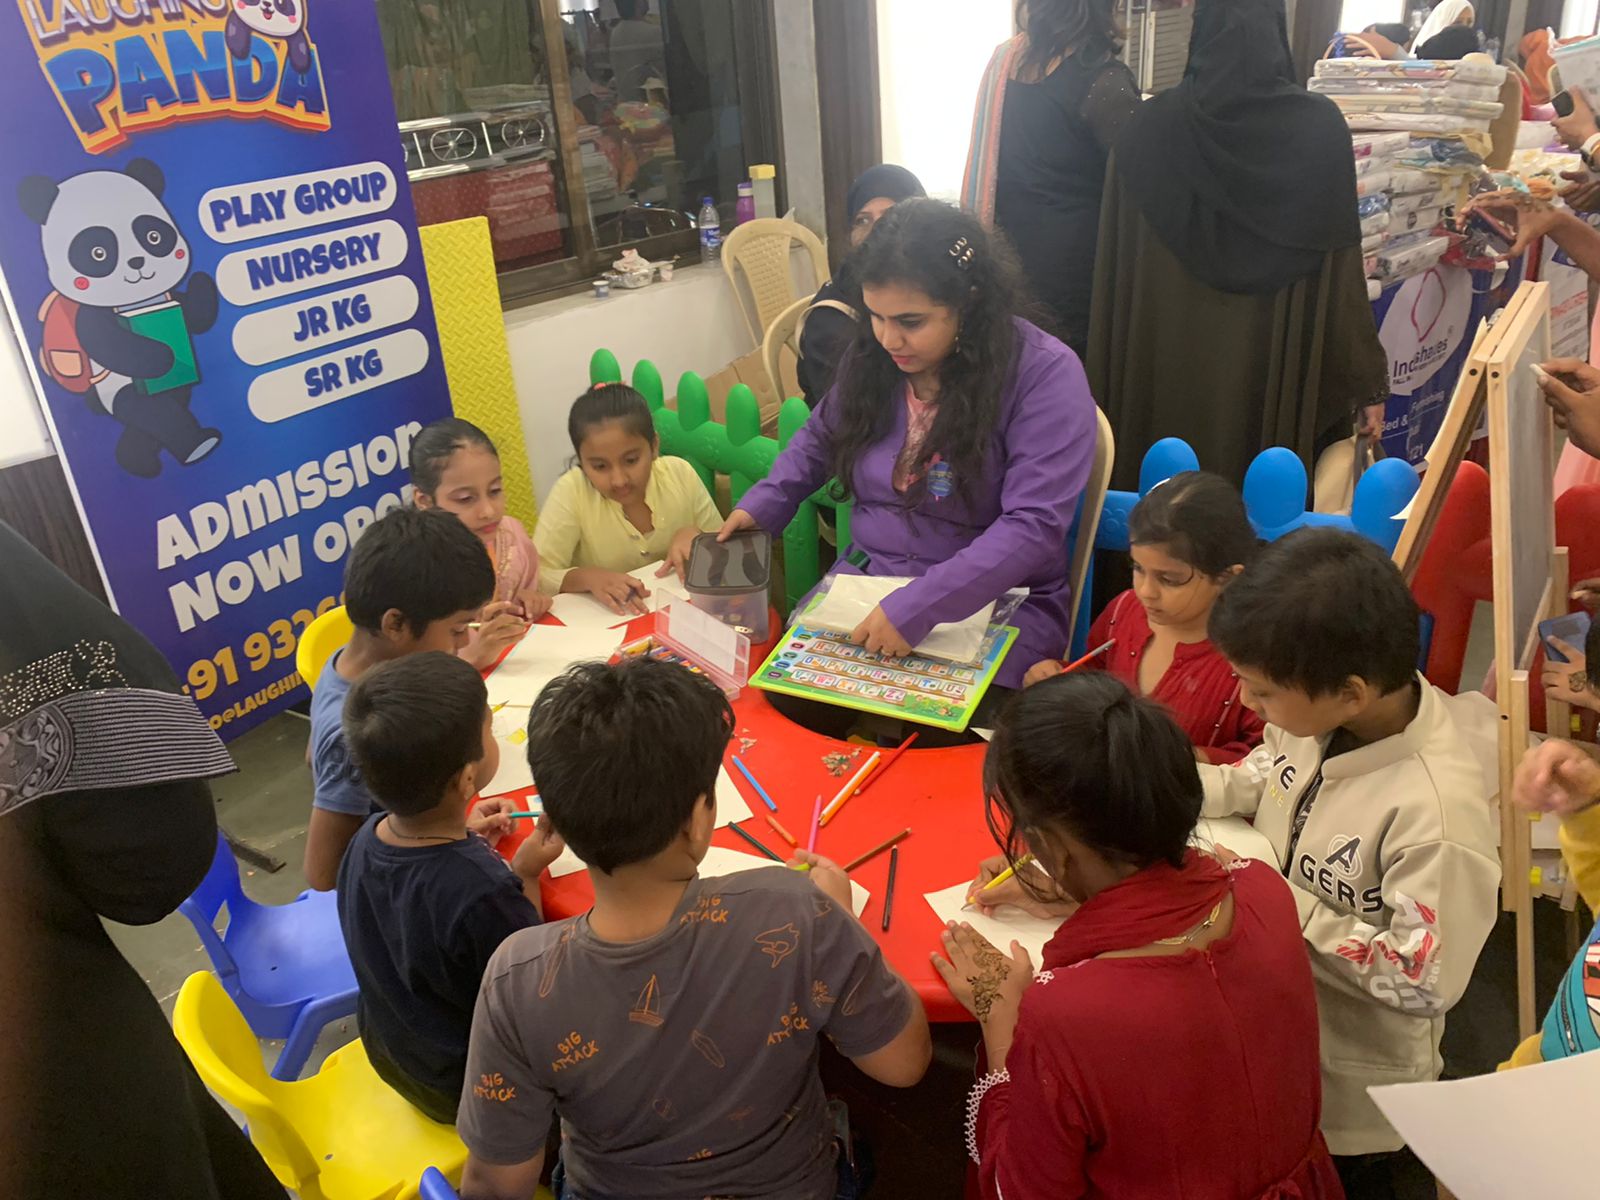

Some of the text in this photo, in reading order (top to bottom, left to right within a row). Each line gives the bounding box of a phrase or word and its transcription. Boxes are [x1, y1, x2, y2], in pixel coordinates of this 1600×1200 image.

[44, 28, 327, 136] PANDA
[209, 171, 388, 233] PLAY GROUP
[246, 232, 382, 291] NURSERY
[293, 294, 372, 342] JR KG
[304, 349, 383, 397] SR KG
[168, 534, 303, 633] NOW
[551, 1039, 600, 1073] ATTACK
[557, 1031, 582, 1055] BIG
[472, 1084, 516, 1103] ATTACK
[480, 1072, 504, 1088] BIG
